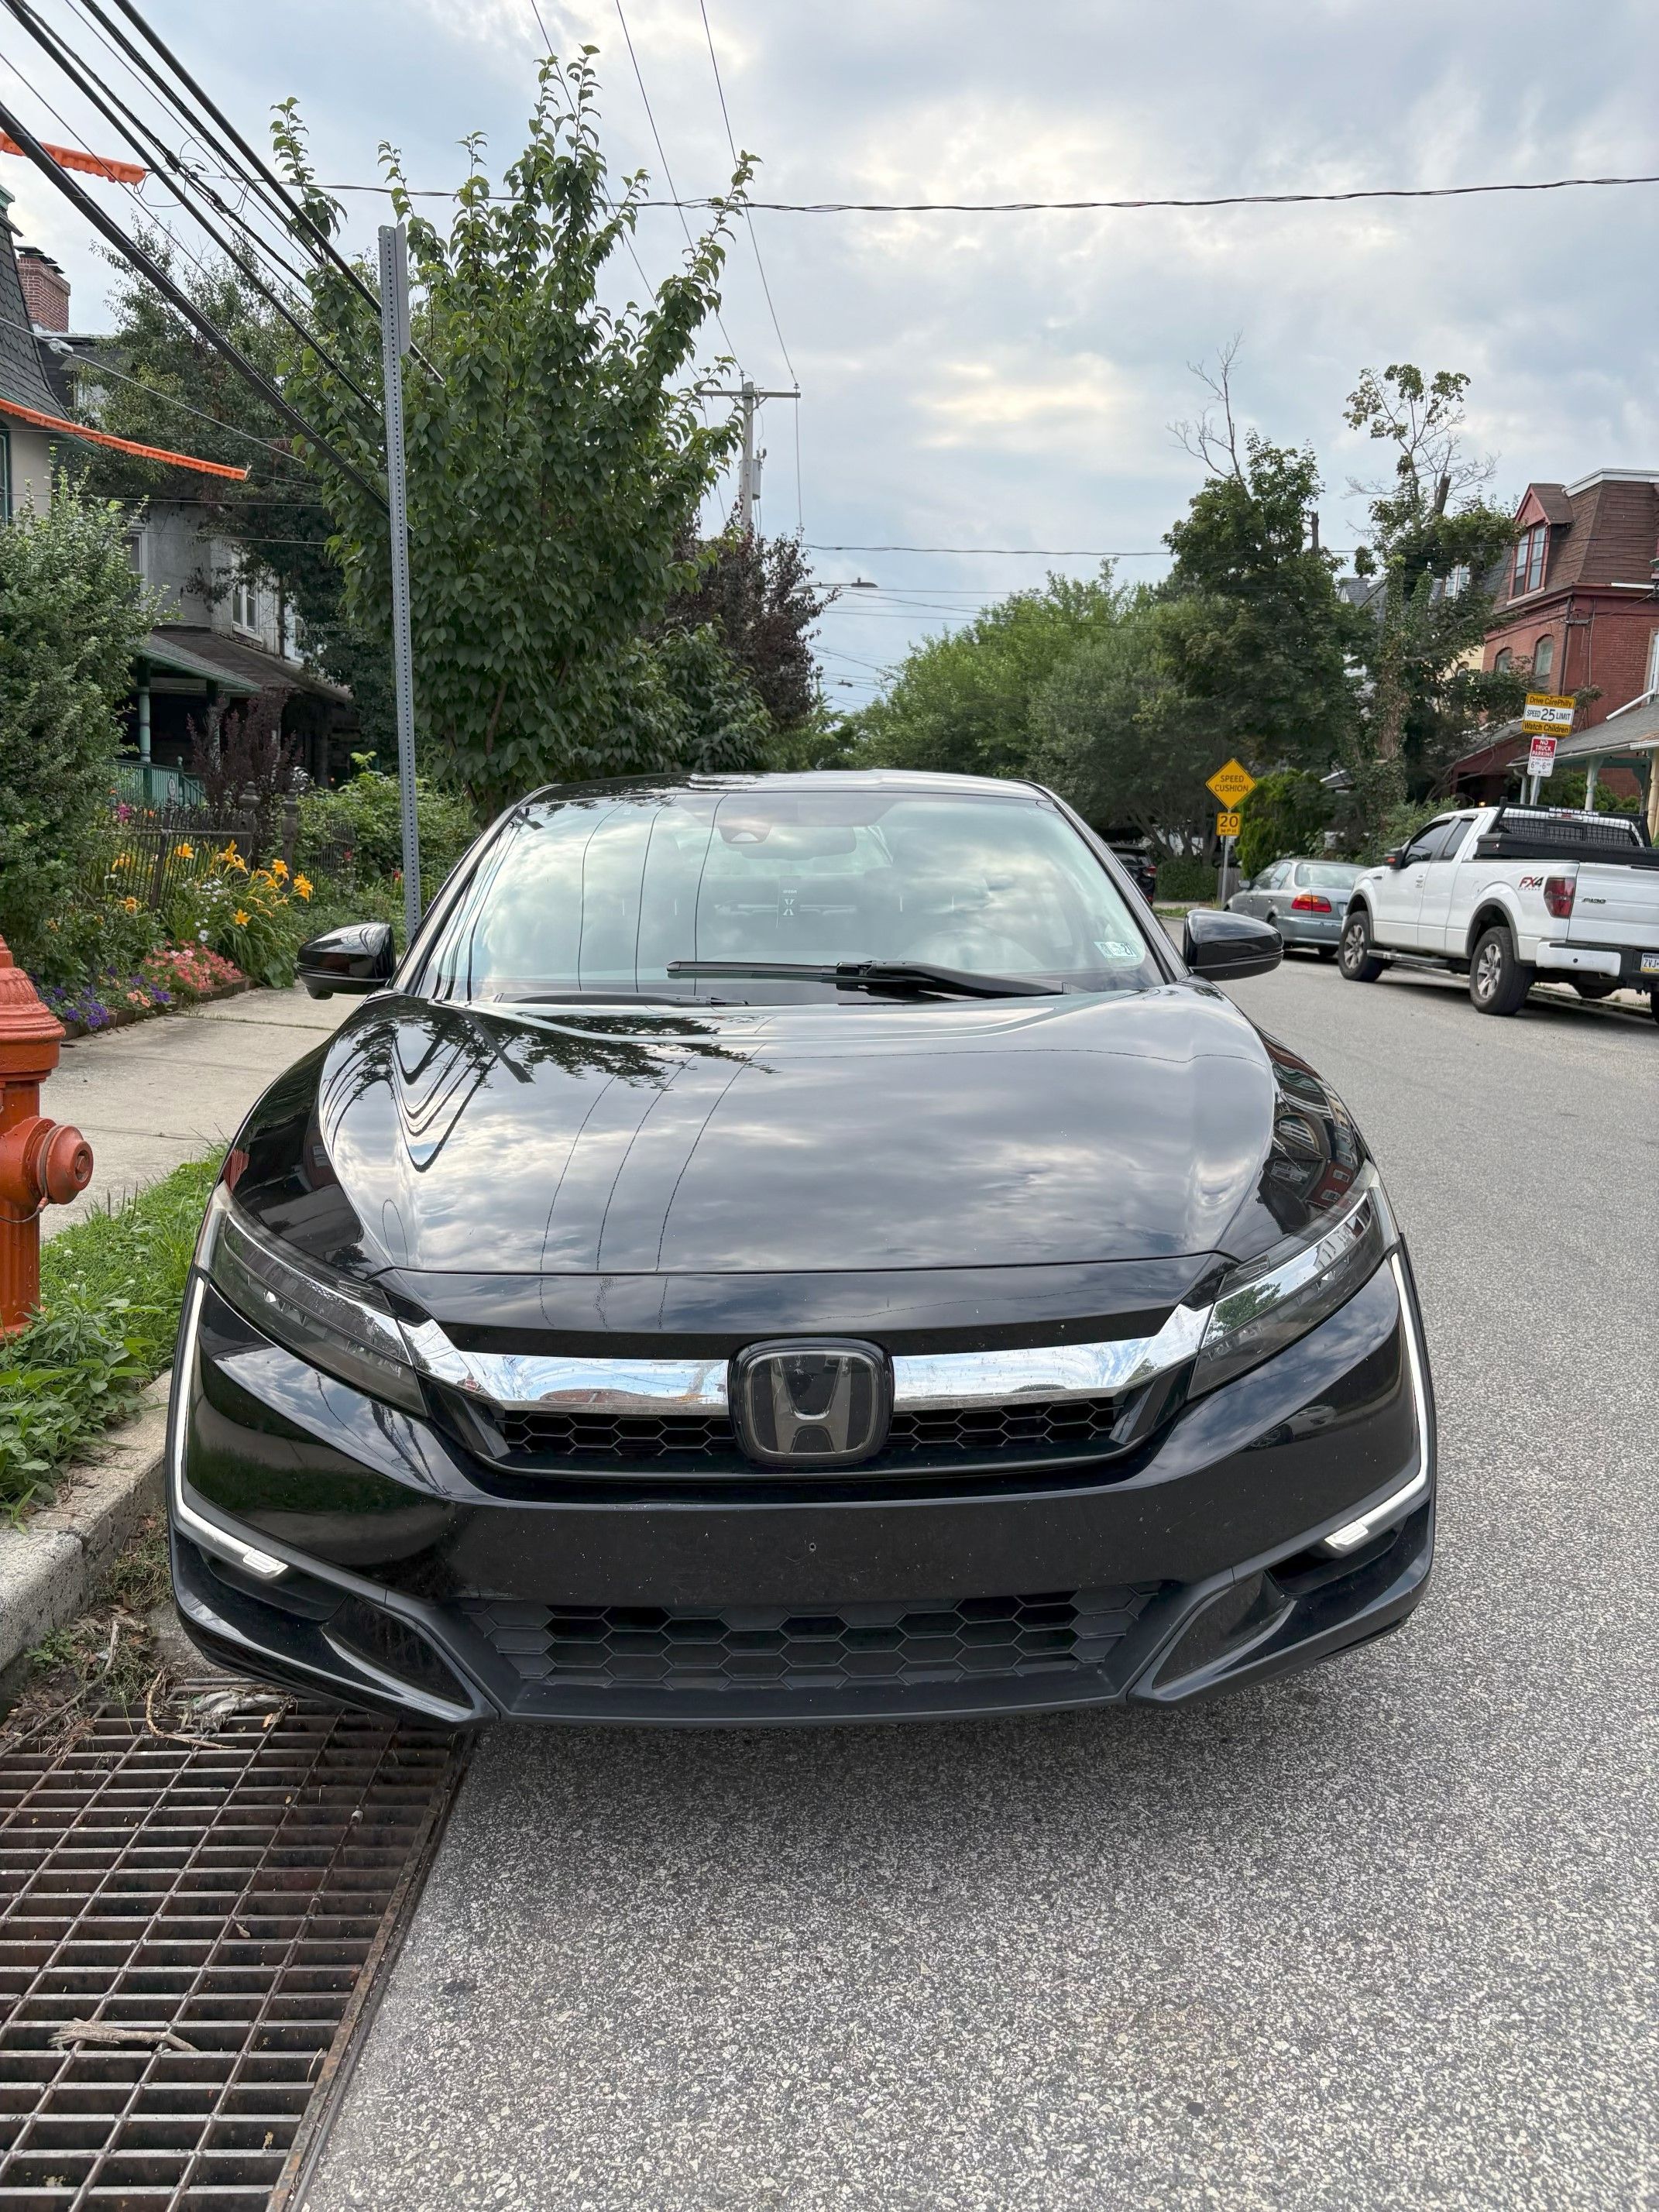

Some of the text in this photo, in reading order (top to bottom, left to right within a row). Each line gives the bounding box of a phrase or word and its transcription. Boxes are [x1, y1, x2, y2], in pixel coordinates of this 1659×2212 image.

[1541, 708, 1555, 721] 25
[1556, 712, 1571, 720] LIMIT
[1524, 722, 1568, 733] Watch Children
[1220, 816, 1238, 827] 20
[1519, 876, 1544, 888] FX4
